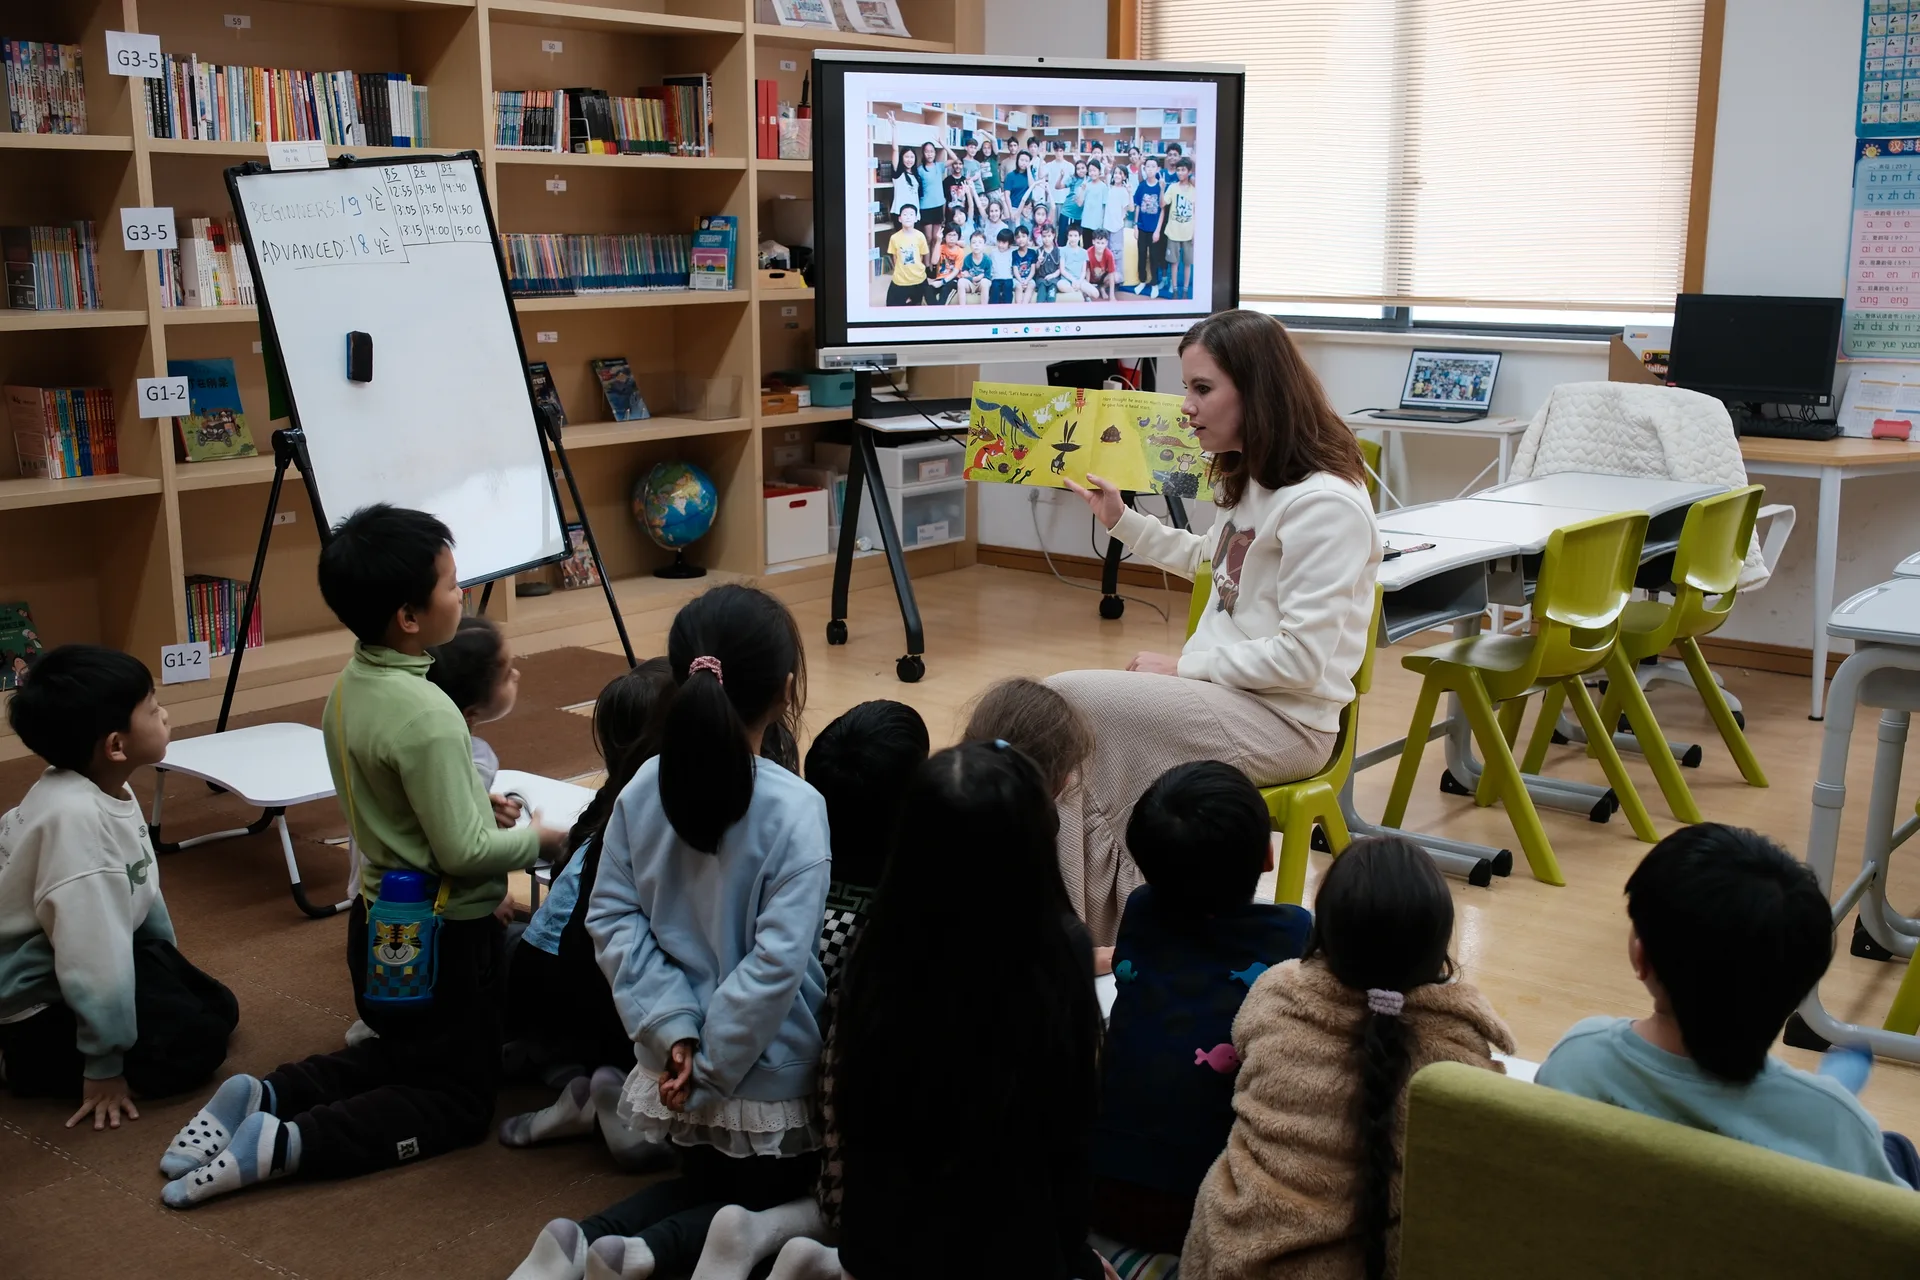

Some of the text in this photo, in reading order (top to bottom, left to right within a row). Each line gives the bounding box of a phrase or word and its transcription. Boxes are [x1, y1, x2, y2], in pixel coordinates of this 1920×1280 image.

[117, 49, 159, 69] G3-5
[384, 167, 398, 181] B5
[1870, 171, 1913, 184] b p m f
[389, 183, 467, 198] 12:55 13:40 14:40
[1867, 192, 1874, 203] q
[1887, 190, 1899, 200] zh
[1903, 190, 1915, 200] ch
[393, 202, 473, 216] 13:05 13:50 14:50
[126, 224, 168, 241] G3-5
[400, 224, 482, 237] 13:15 14:00 15:00
[262, 239, 349, 266] ADVANCED:
[1861, 244, 1871, 253] ai
[1875, 244, 1883, 253] ei
[1861, 271, 1875, 279] an
[1886, 271, 1899, 279] en
[1859, 296, 1909, 306] ang eng
[1853, 321, 1865, 331] zhi
[1870, 321, 1882, 331] chi
[1887, 321, 1899, 331] shi
[146, 384, 186, 402] G1-2
[978, 388, 988, 396] They
[164, 649, 202, 668] G1-2
